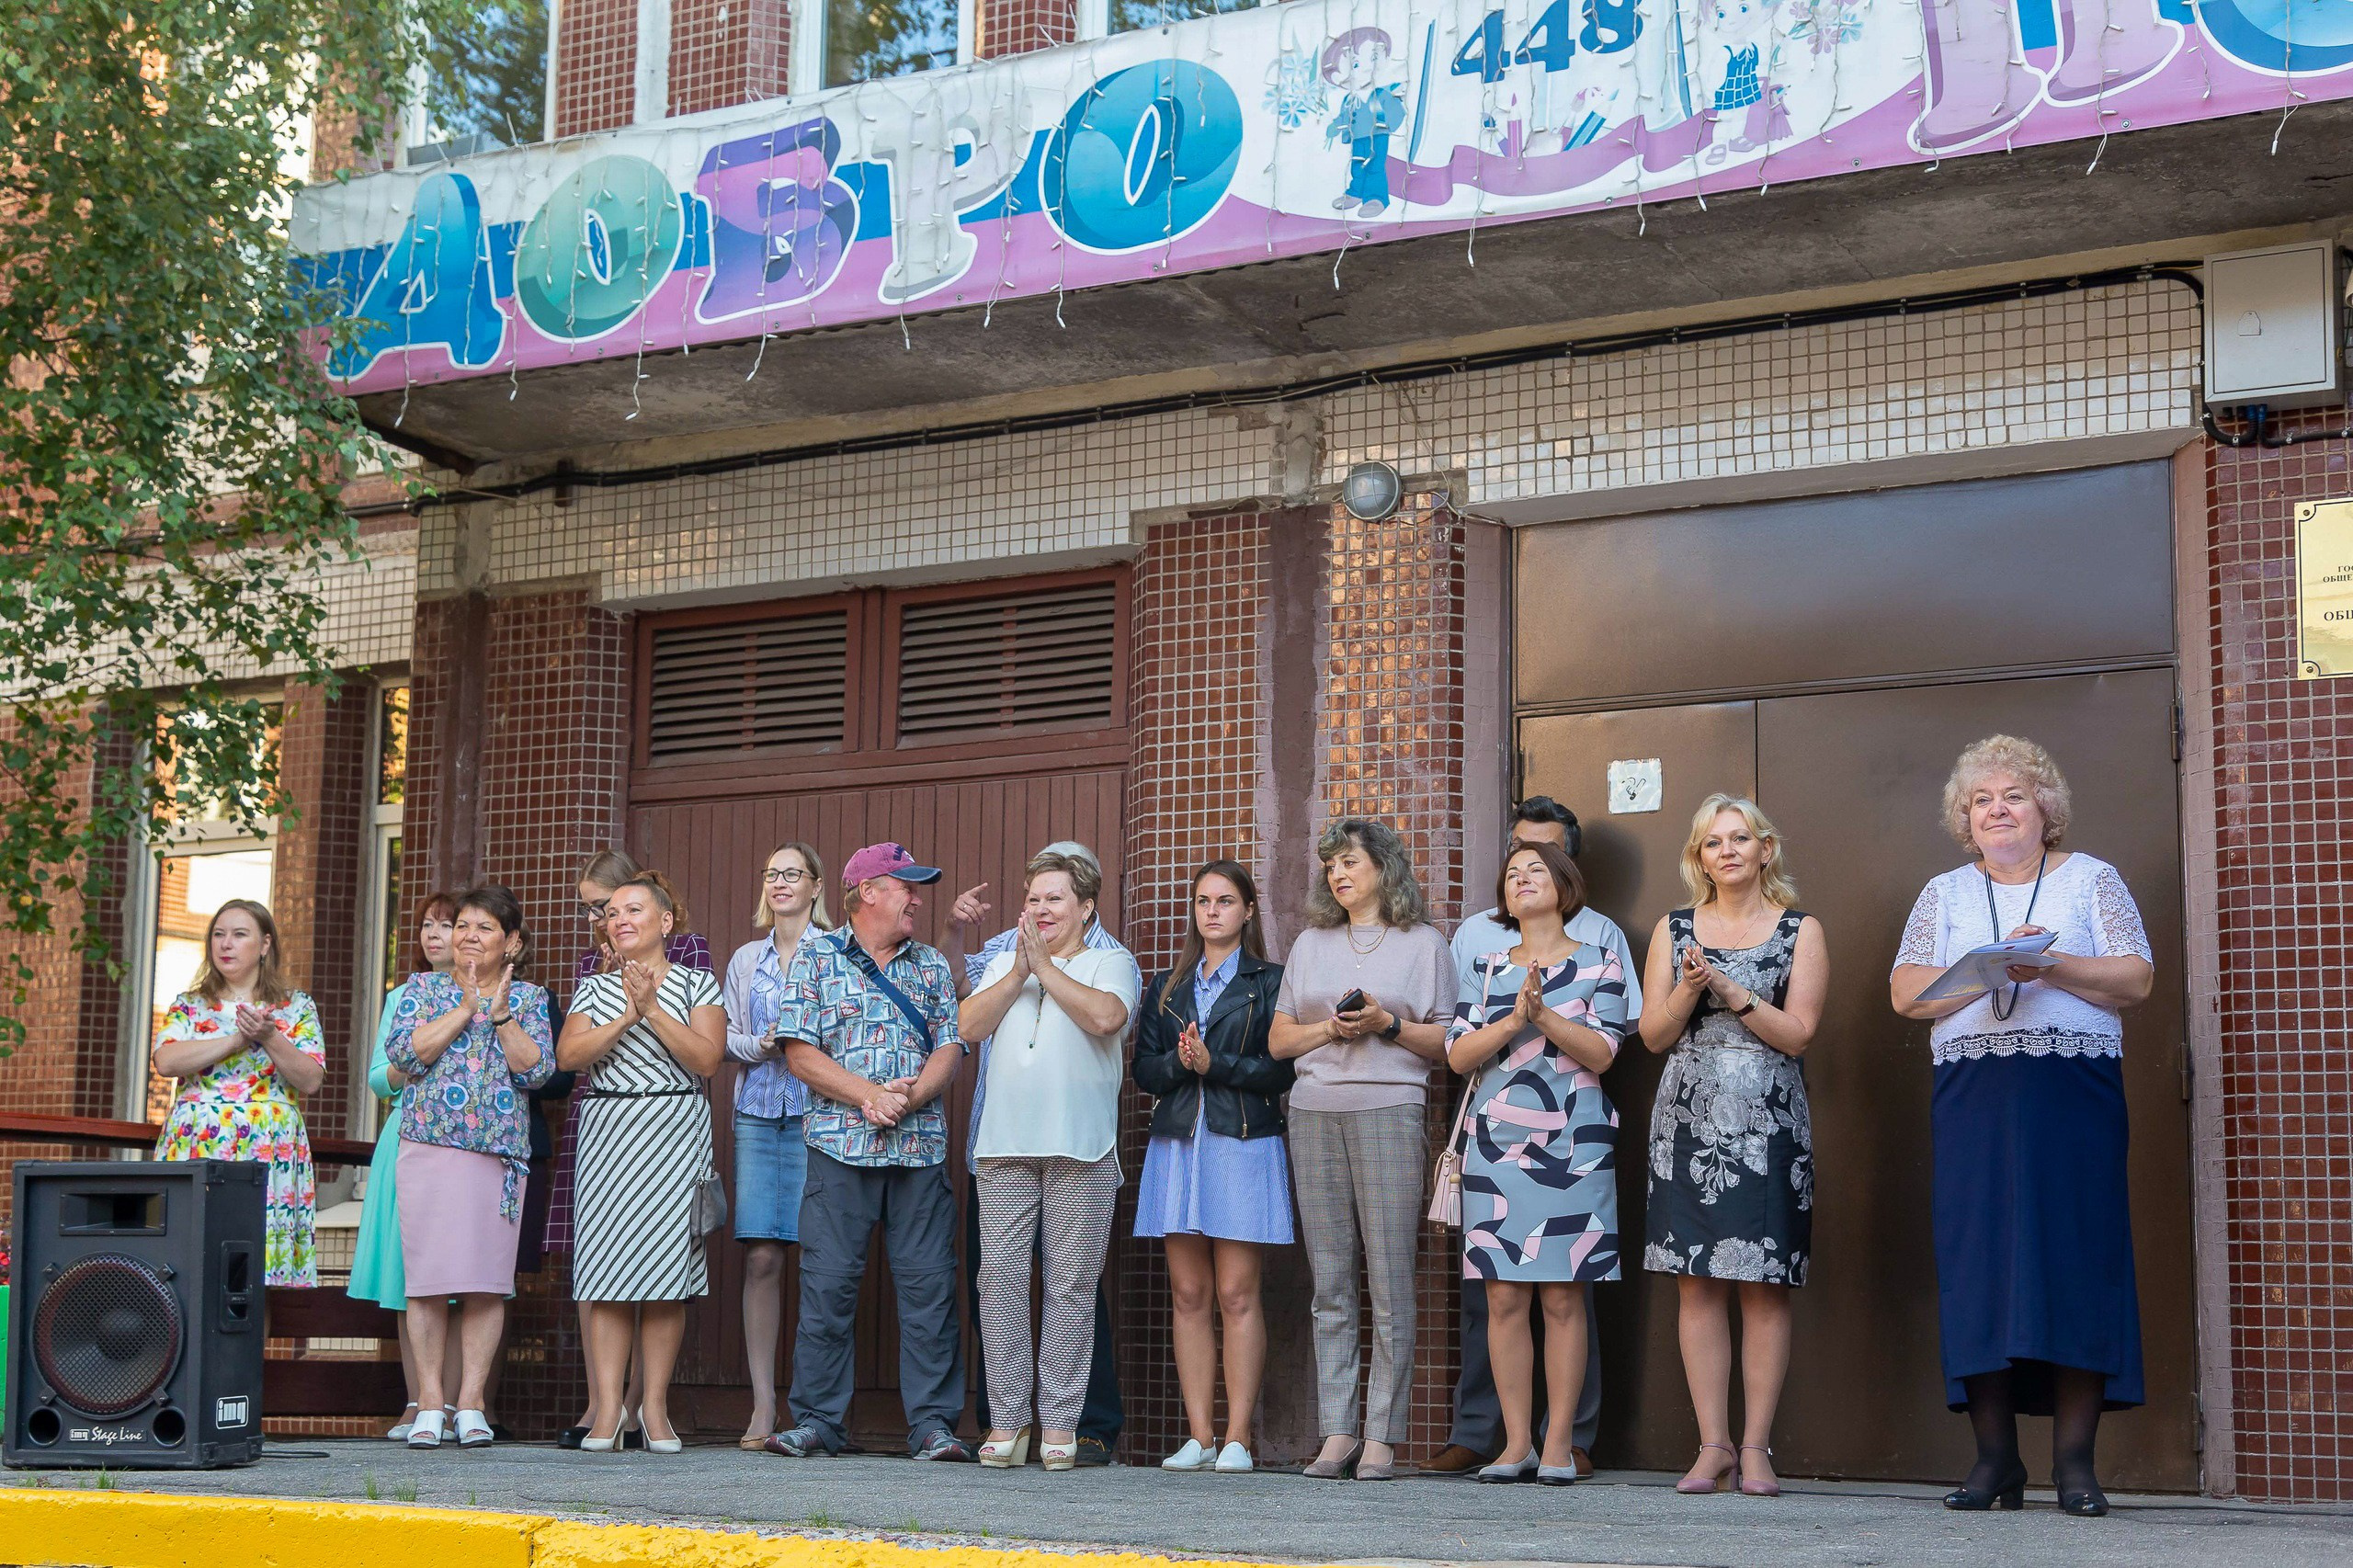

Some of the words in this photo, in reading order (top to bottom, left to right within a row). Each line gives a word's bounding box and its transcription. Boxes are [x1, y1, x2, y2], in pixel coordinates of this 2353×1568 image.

[1451, 0, 1643, 83] 448
[91, 1426, 118, 1446] Stage
[119, 1426, 142, 1440] Line
